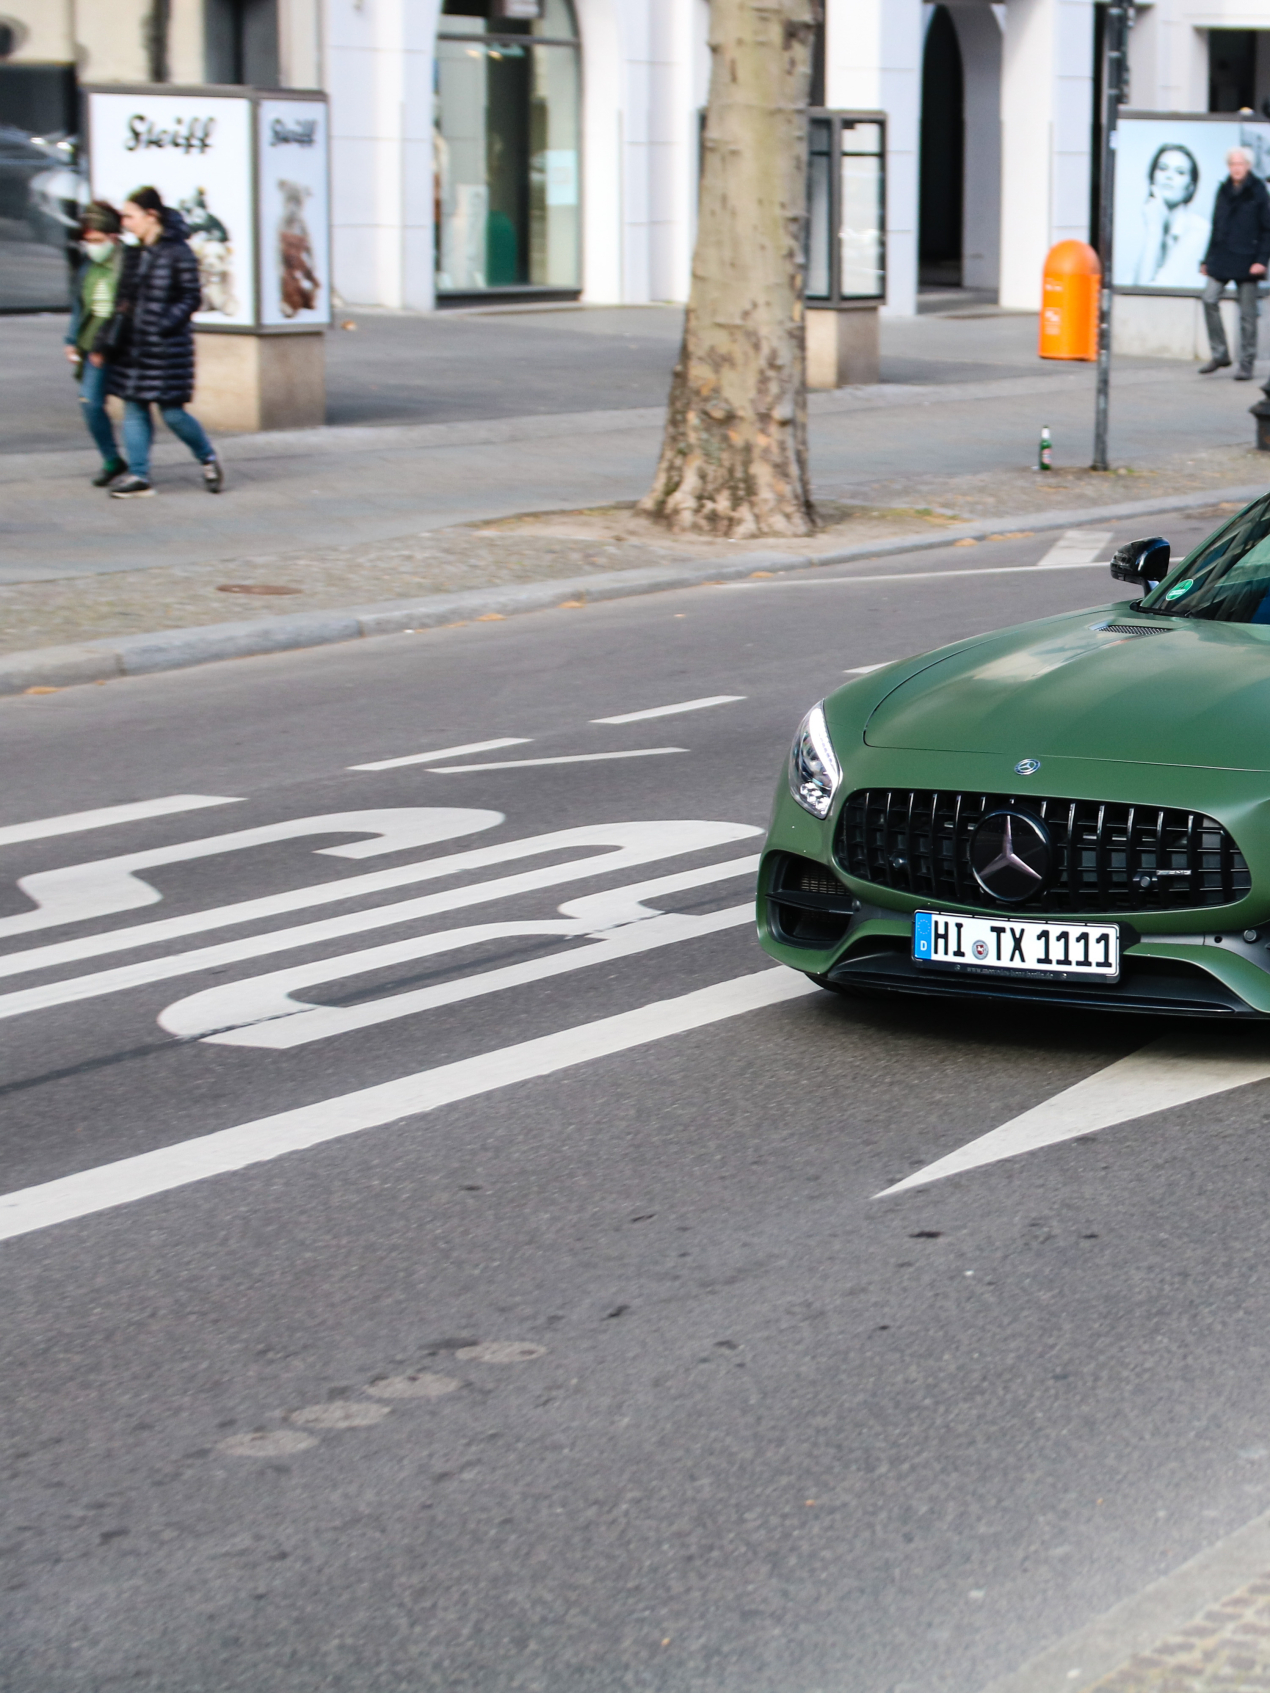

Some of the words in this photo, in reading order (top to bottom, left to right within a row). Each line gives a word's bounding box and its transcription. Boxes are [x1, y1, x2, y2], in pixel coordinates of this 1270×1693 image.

[124, 114, 217, 153] Steiff
[269, 118, 318, 148] Steiff
[919, 940, 928, 951] D
[933, 919, 966, 958] HI
[989, 926, 1026, 963] TX
[1036, 929, 1113, 968] 1111
